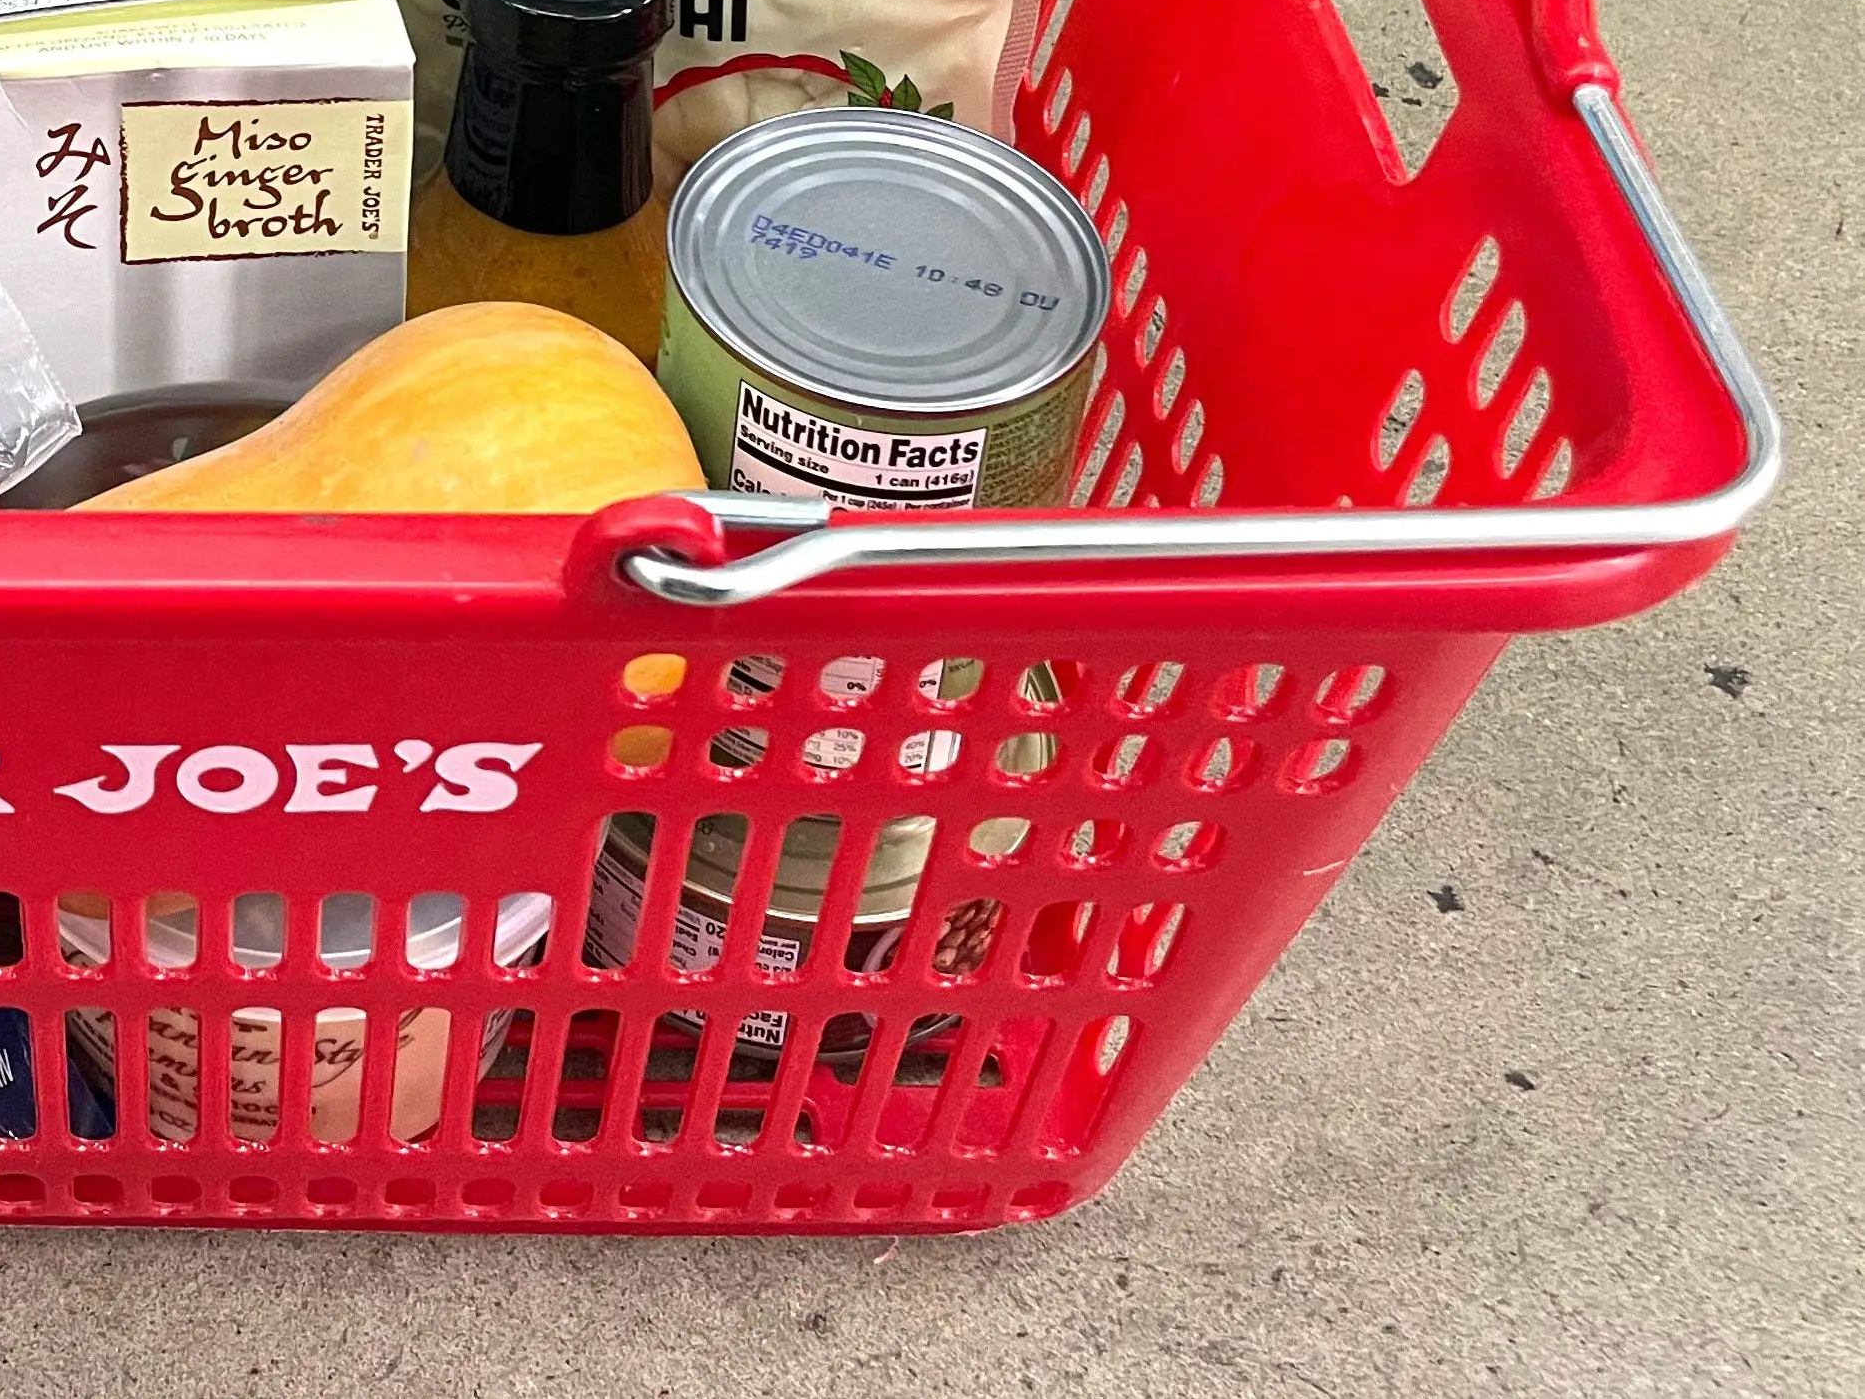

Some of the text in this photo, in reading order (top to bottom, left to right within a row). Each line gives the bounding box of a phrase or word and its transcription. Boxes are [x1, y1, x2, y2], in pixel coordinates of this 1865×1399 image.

[38, 32, 268, 53] AND WITHIN DAYS
[193, 115, 312, 157] Miso
[362, 113, 385, 181] TRADER
[36, 122, 111, 250] みそ
[150, 156, 335, 221] Ginger
[207, 190, 344, 240] broth
[739, 424, 829, 474] Serving size
[741, 387, 880, 466] Nutrition
[888, 437, 979, 468] Facts
[889, 469, 975, 490] can (416g)
[54, 739, 544, 814] JOE'S
